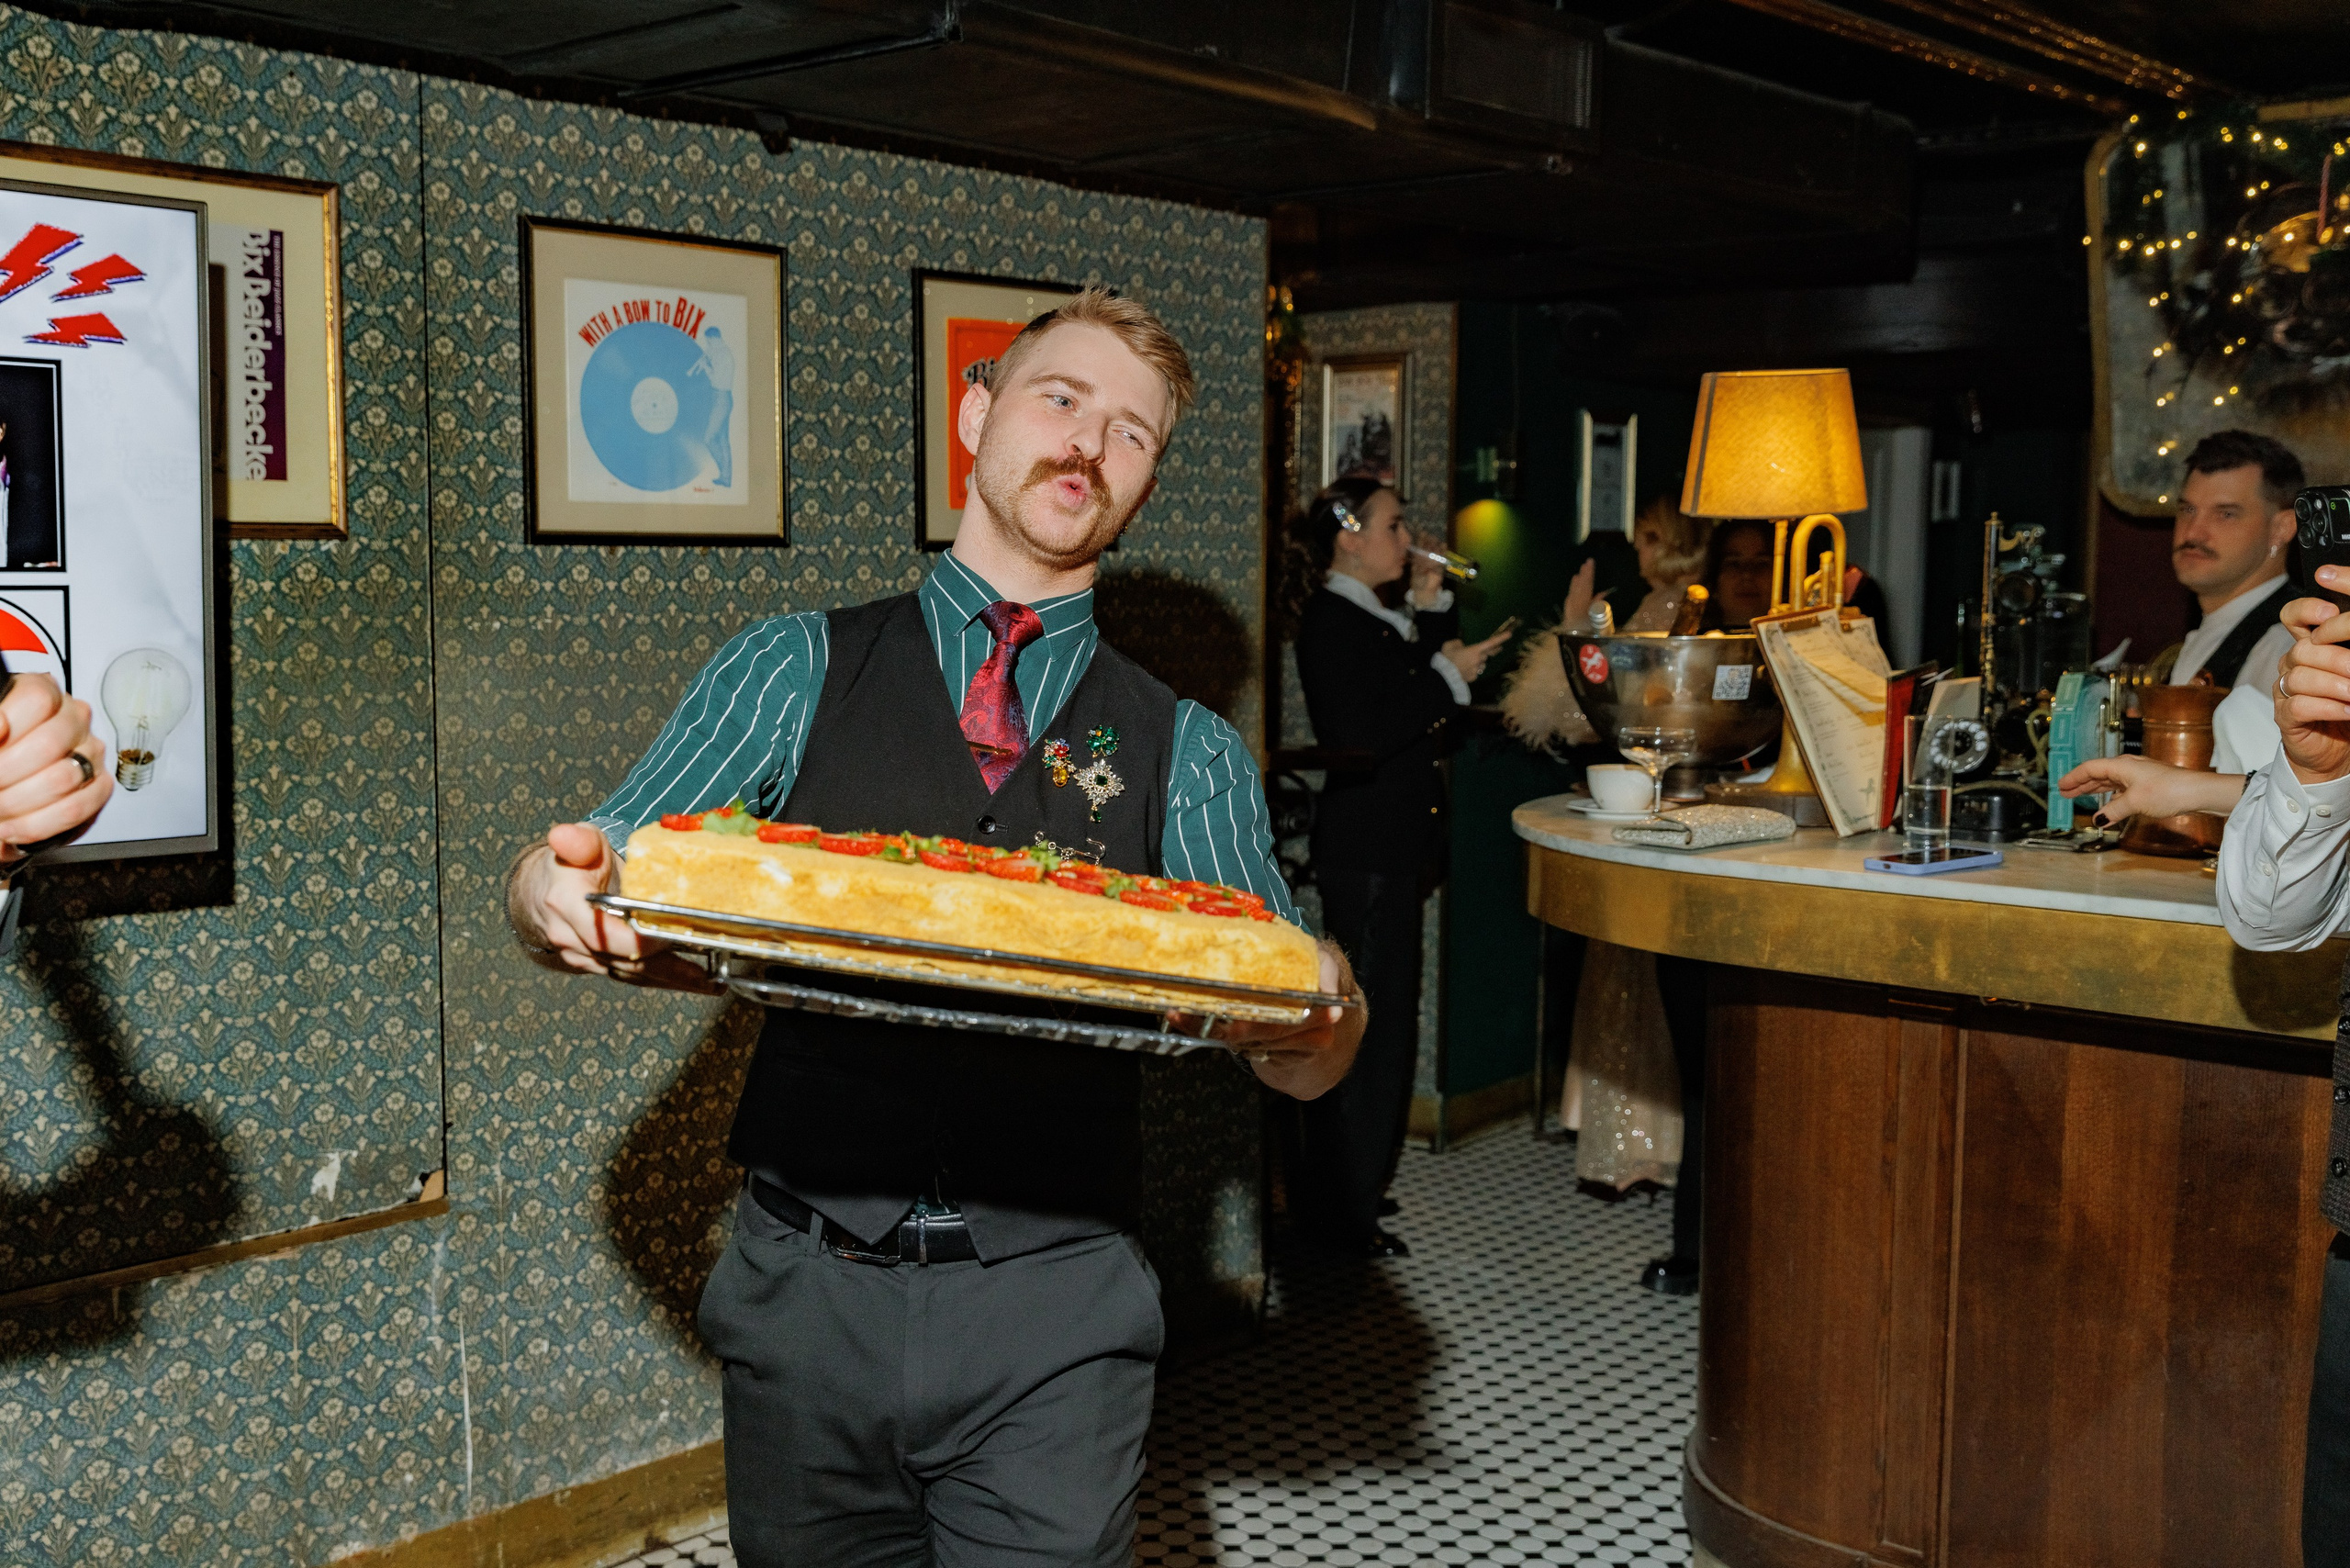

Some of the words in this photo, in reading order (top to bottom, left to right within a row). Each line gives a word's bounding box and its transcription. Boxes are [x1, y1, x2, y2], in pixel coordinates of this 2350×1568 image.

[242, 227, 271, 276] Bix
[578, 310, 614, 348] WITH
[611, 304, 624, 329] A
[622, 298, 651, 325] BOW
[655, 298, 671, 325] TO
[672, 295, 706, 340] BIX
[242, 277, 274, 481] Beiderbecke
